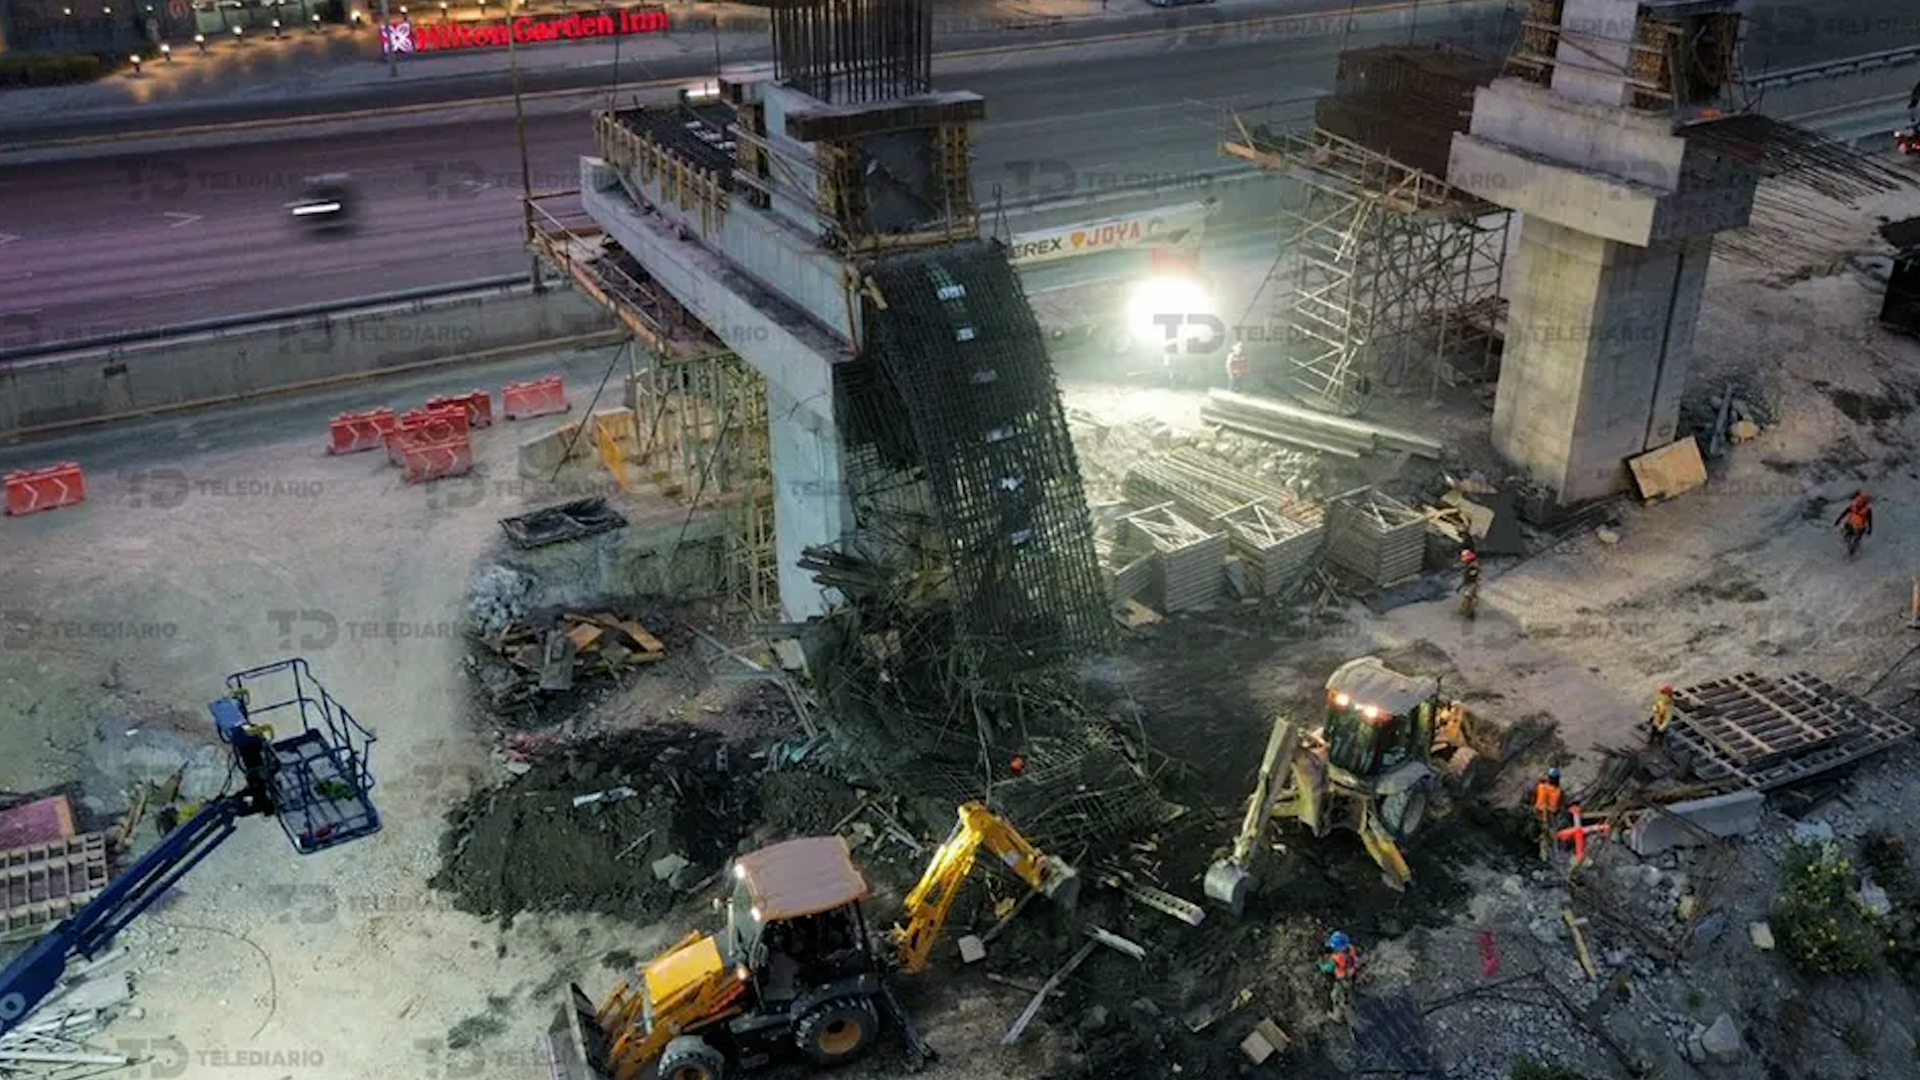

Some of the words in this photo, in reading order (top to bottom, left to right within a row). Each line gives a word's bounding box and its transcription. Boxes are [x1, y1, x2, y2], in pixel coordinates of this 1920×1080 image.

[416, 22, 510, 51] Hilton
[514, 15, 614, 46] Garden
[619, 8, 669, 32] Inn
[1087, 221, 1140, 246] JOYA
